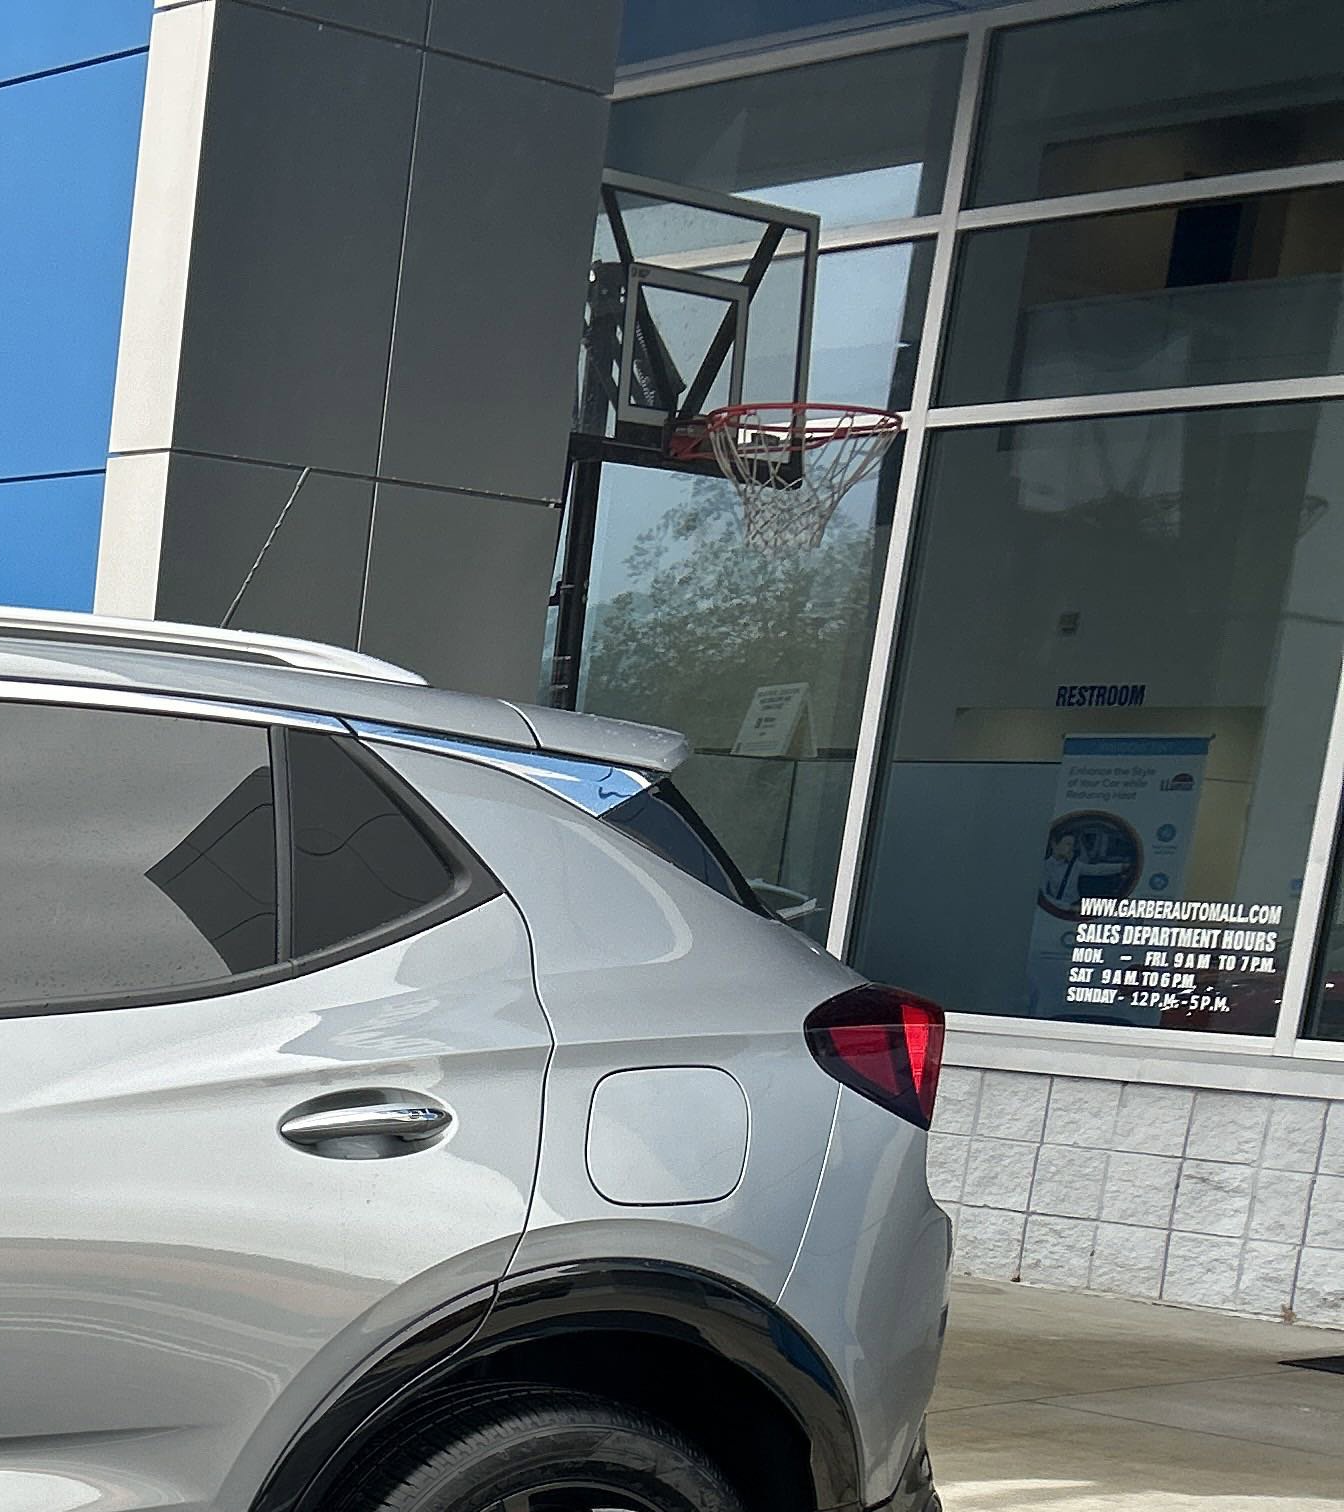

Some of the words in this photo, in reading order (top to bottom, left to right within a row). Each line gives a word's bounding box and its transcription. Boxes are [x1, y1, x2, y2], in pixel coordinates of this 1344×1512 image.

[1055, 684, 1146, 707] RESTROOM
[1080, 897, 1282, 924] WWW.GARBERAUTOMALL.COM
[1076, 923, 1122, 944] SALES
[1121, 925, 1221, 949] DEPARTMENT
[1221, 929, 1278, 952] HOURS
[1072, 947, 1105, 964] MON.
[1218, 955, 1237, 971] TO
[1069, 967, 1094, 982] SAT
